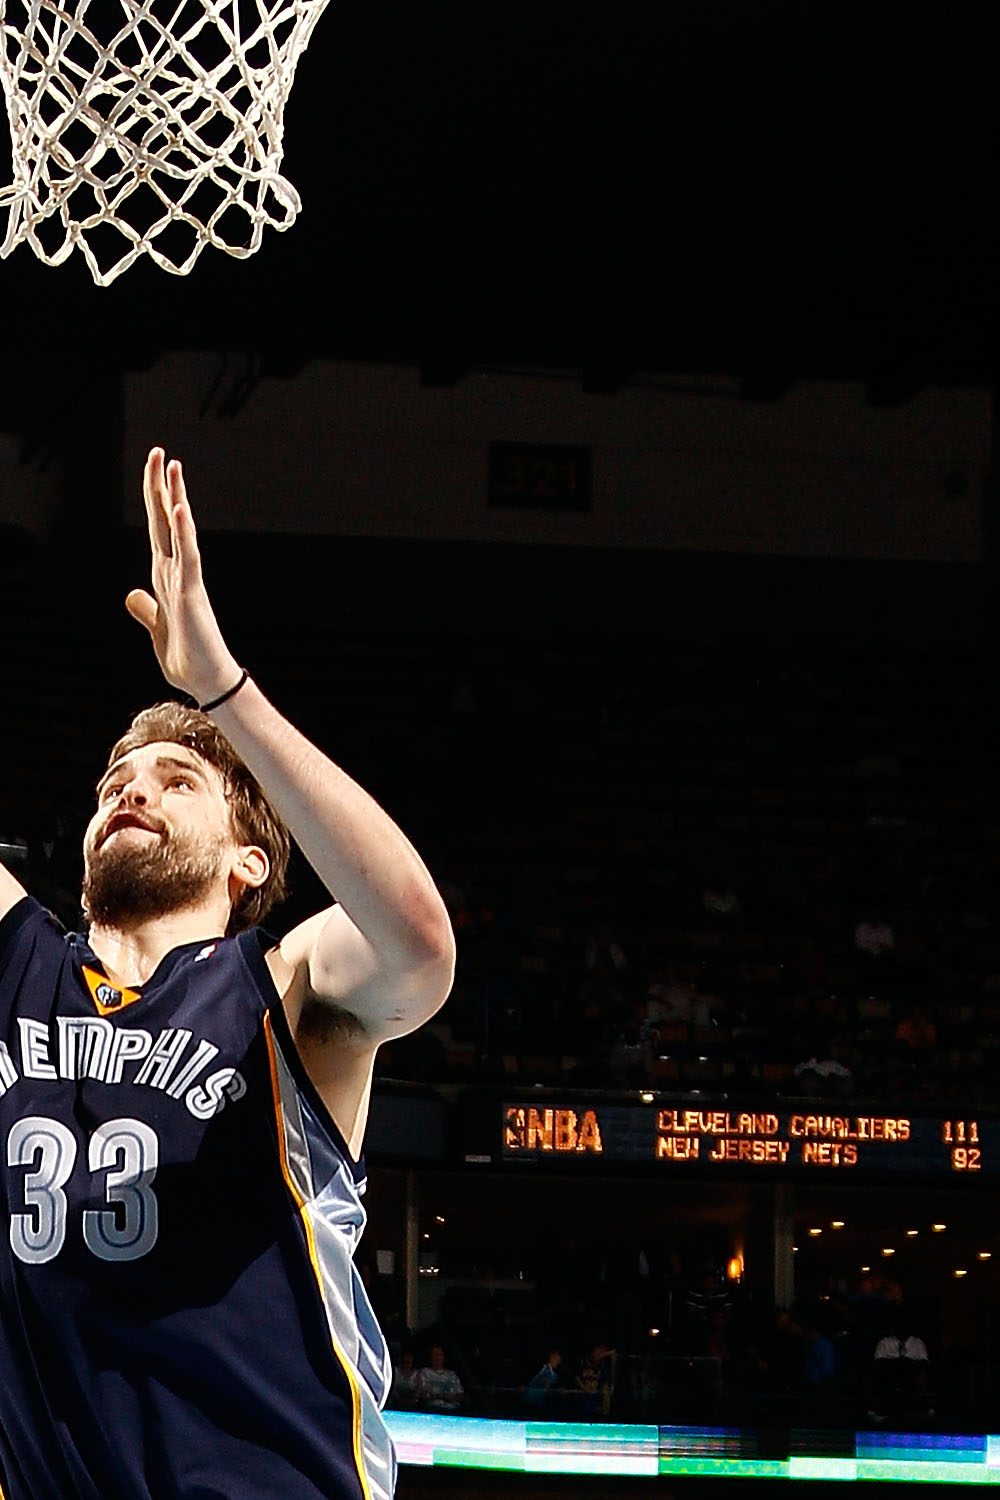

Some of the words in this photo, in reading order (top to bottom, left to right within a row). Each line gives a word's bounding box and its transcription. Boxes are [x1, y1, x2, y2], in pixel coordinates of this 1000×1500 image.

[502, 455, 578, 498] 321
[526, 1108, 604, 1152] NBA
[657, 1109, 780, 1135] CLEVELAND
[790, 1115, 911, 1141] CAVALIERS
[943, 1120, 980, 1143] 111
[657, 1136, 700, 1159] NEW
[711, 1138, 791, 1163] JERSEY
[803, 1141, 859, 1166] NETS
[953, 1147, 983, 1170] 92
[7, 1116, 159, 1265] 33
